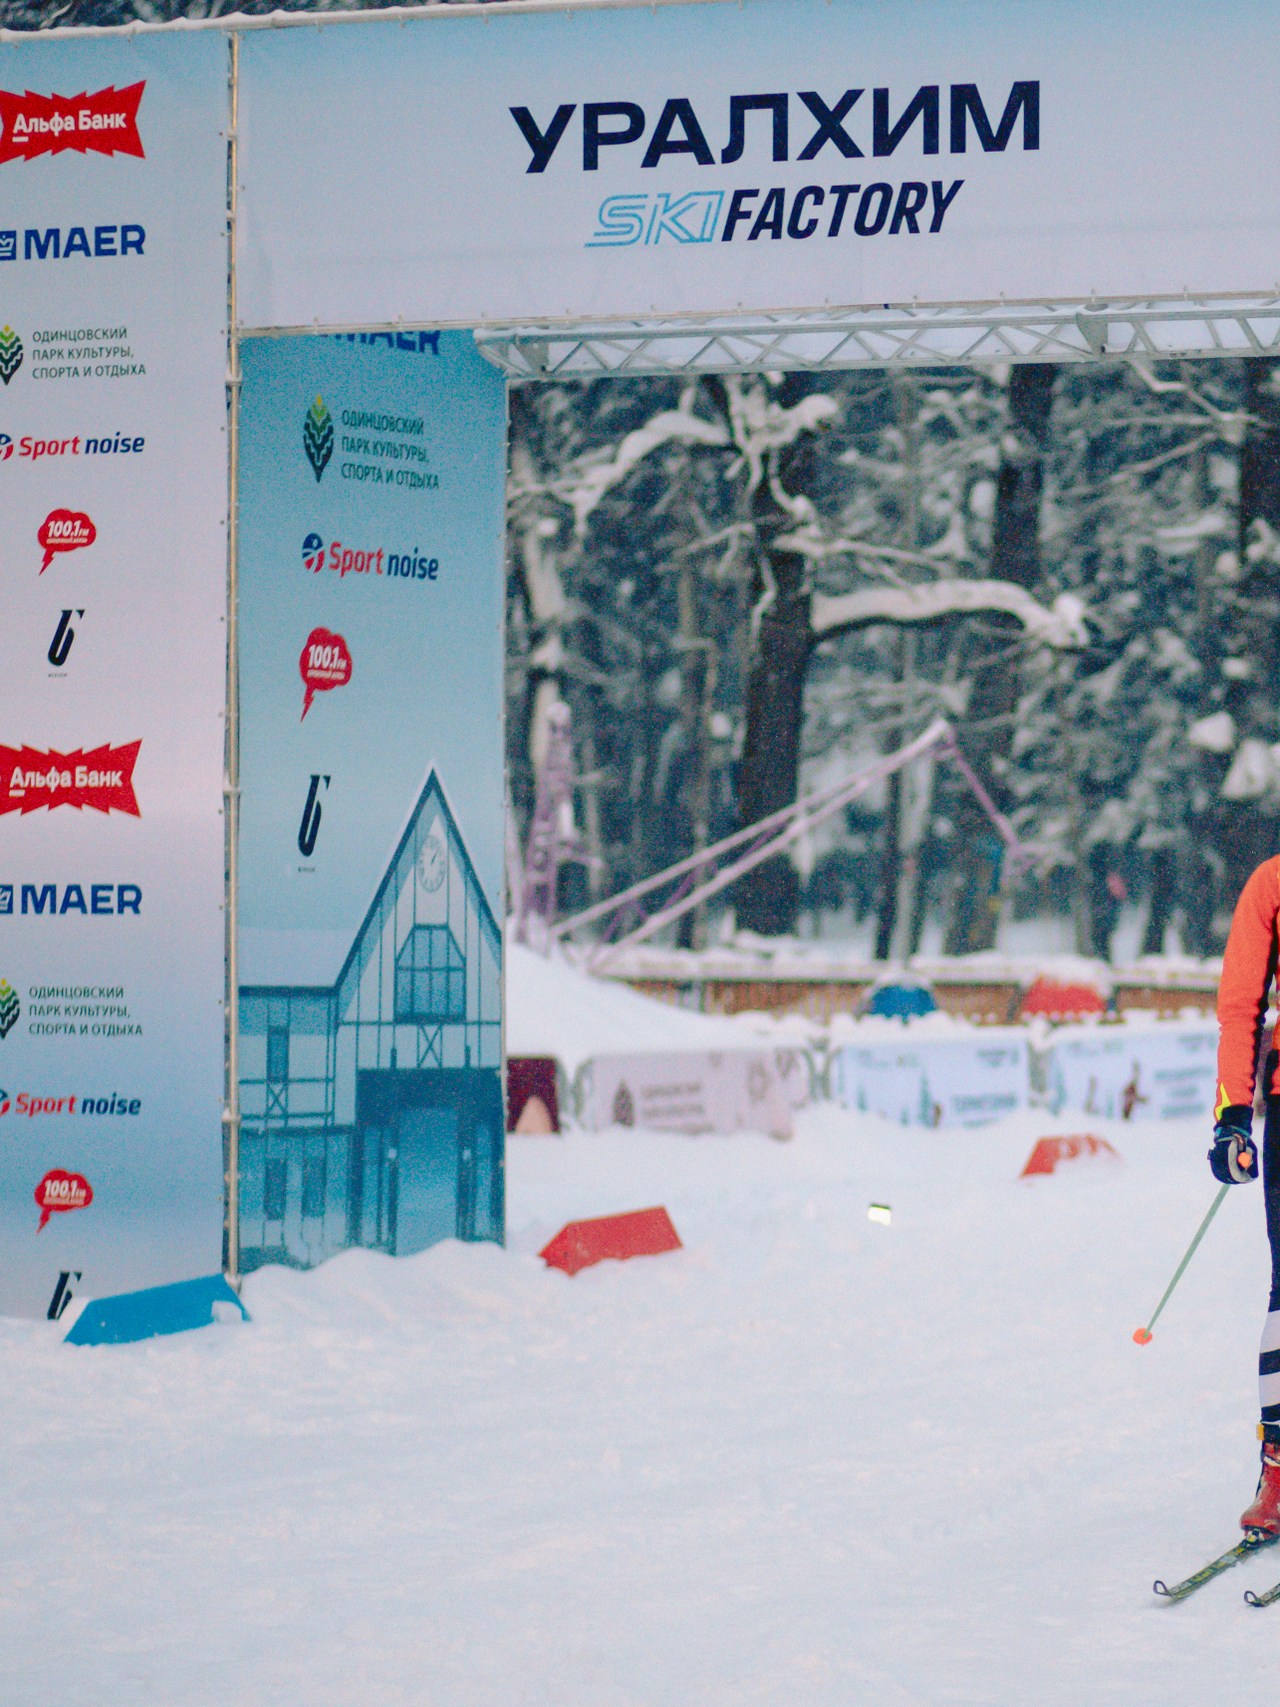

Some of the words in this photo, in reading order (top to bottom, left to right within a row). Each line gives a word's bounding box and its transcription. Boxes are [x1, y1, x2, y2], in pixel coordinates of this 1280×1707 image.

[12, 111, 76, 139] Альфа
[78, 109, 127, 131] Банк
[508, 80, 1040, 174] УРАЛХИМ
[24, 223, 146, 260] MAER
[32, 326, 128, 343] ОДИНЦОВСКИЙ
[334, 329, 441, 355] AER
[32, 348, 65, 361] ПАРК
[32, 366, 80, 379] СПОРТА
[83, 365, 92, 377] И
[95, 364, 146, 378] ОТДЫХА
[341, 409, 424, 435] ОДИНЦОВСКИЙ
[341, 436, 370, 453] ПАРК
[341, 462, 383, 482] СПОРТА
[385, 468, 394, 484] И
[395, 469, 440, 489] ОТДЫХА
[9, 765, 72, 794] Альфа
[75, 765, 123, 788] Банк
[21, 883, 143, 914] MAER
[28, 986, 125, 999] ОДИНЦОВСКИЙ
[28, 1004, 61, 1017] ПАРК
[28, 1022, 77, 1036] СПОРТА
[79, 1023, 89, 1036] И
[91, 1023, 143, 1037] ОТДЫХА
